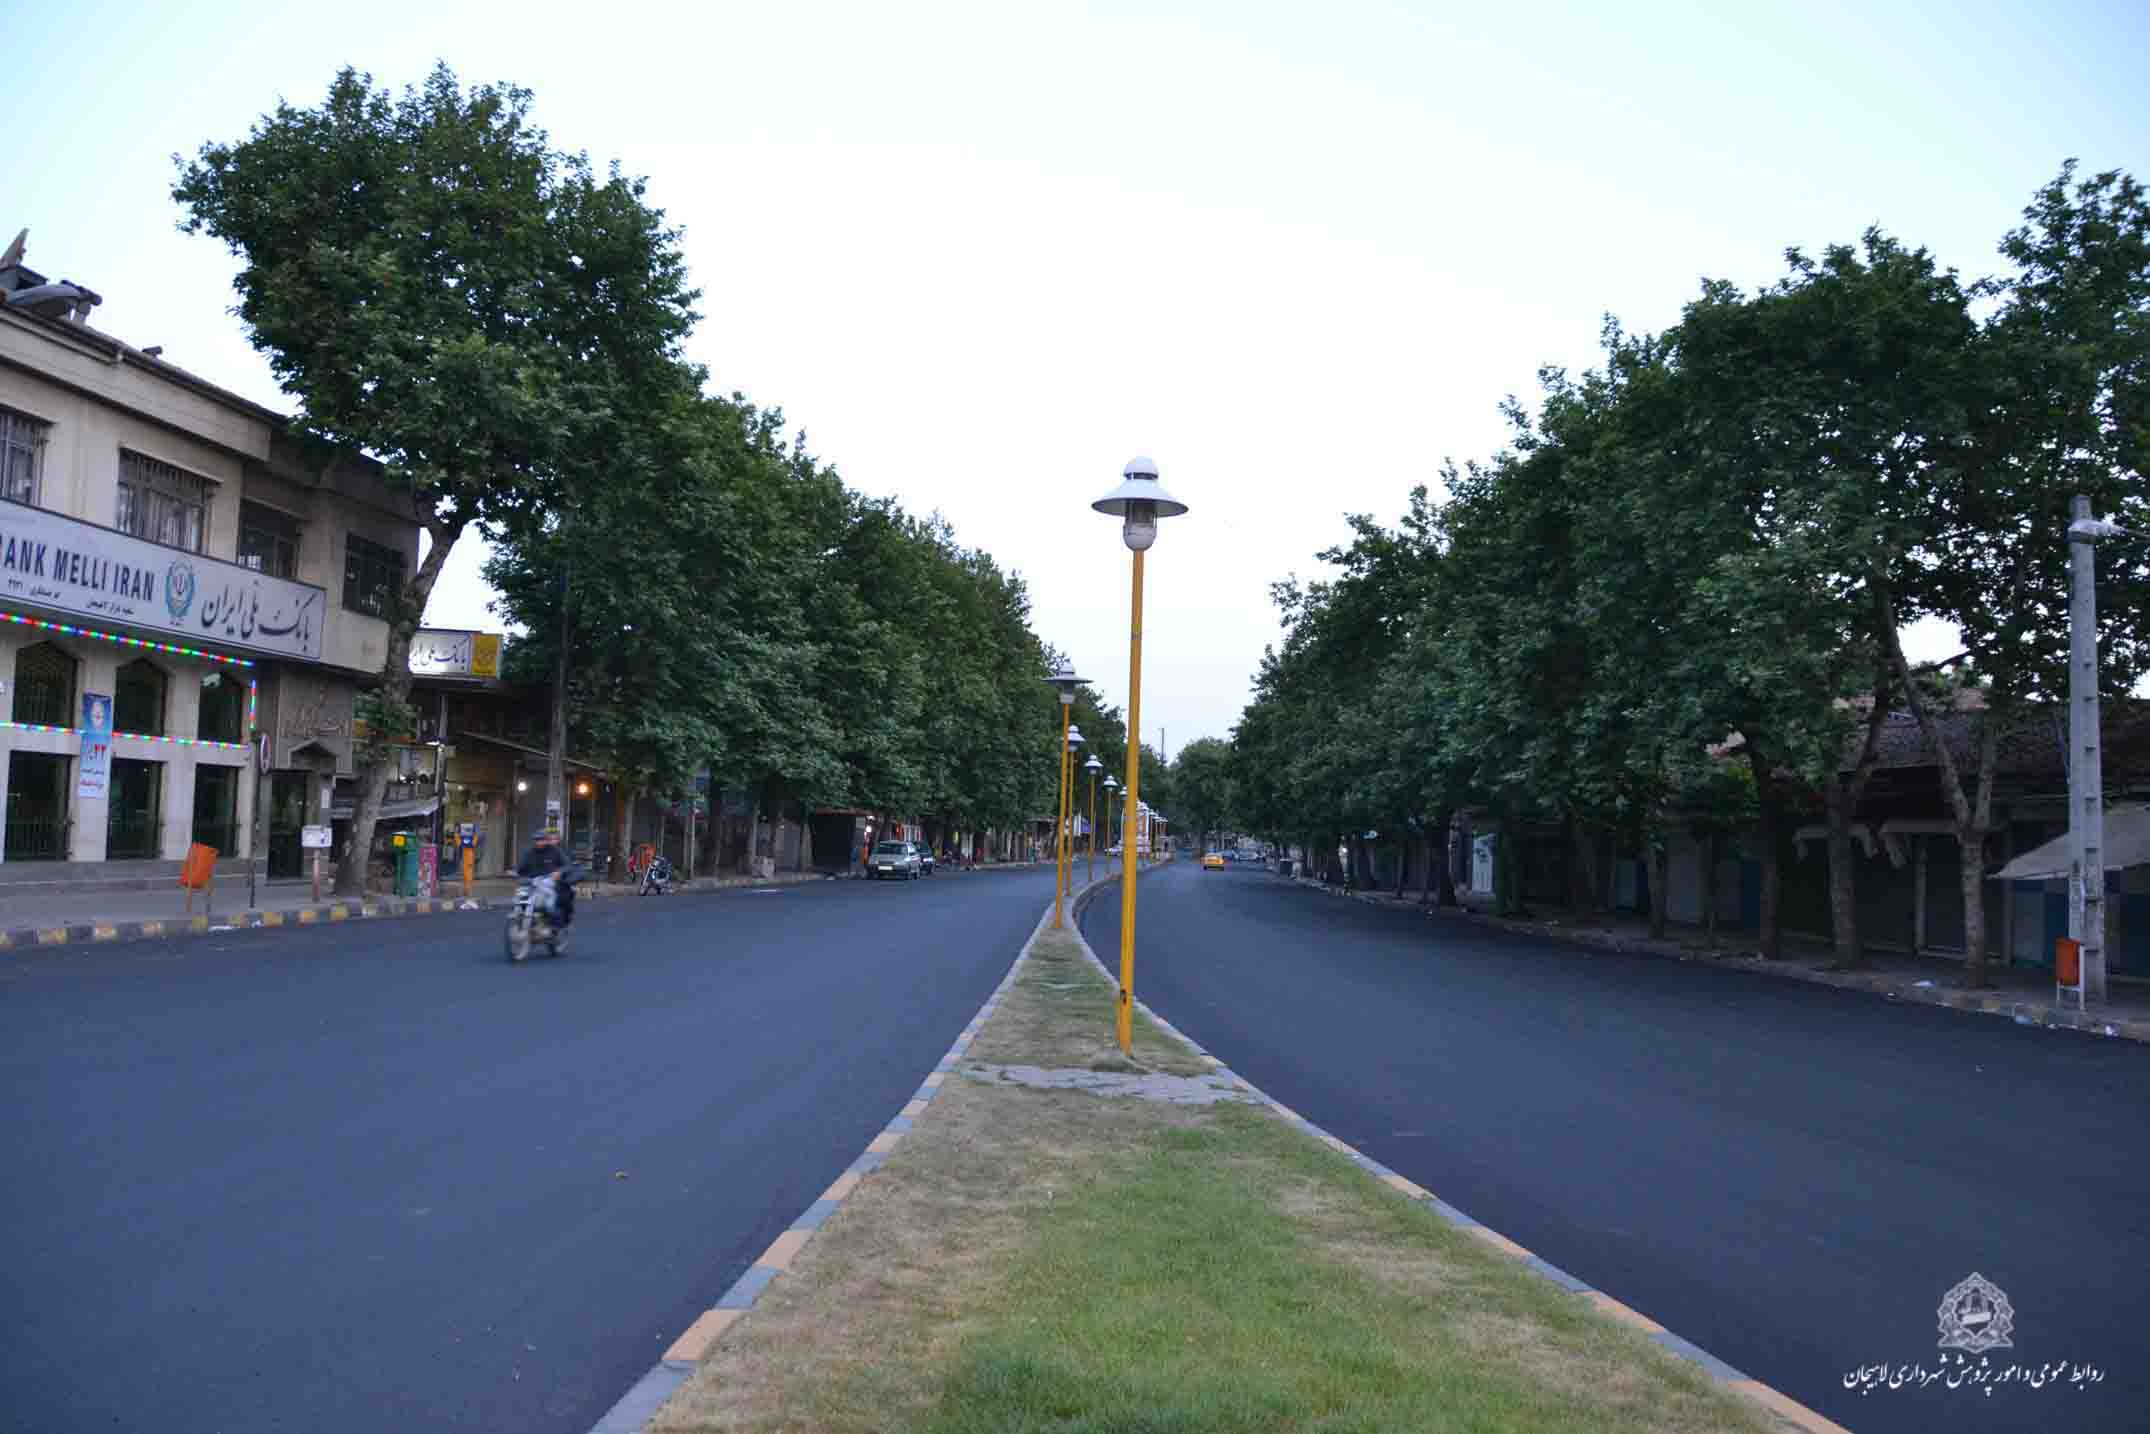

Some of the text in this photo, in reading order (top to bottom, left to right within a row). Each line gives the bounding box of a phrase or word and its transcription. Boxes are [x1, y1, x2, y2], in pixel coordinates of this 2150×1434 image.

[0, 532, 47, 576] ANK
[53, 547, 108, 591] MELLI
[113, 562, 155, 601] IRAN
[201, 584, 243, 635] ایران
[258, 591, 317, 651] بانک
